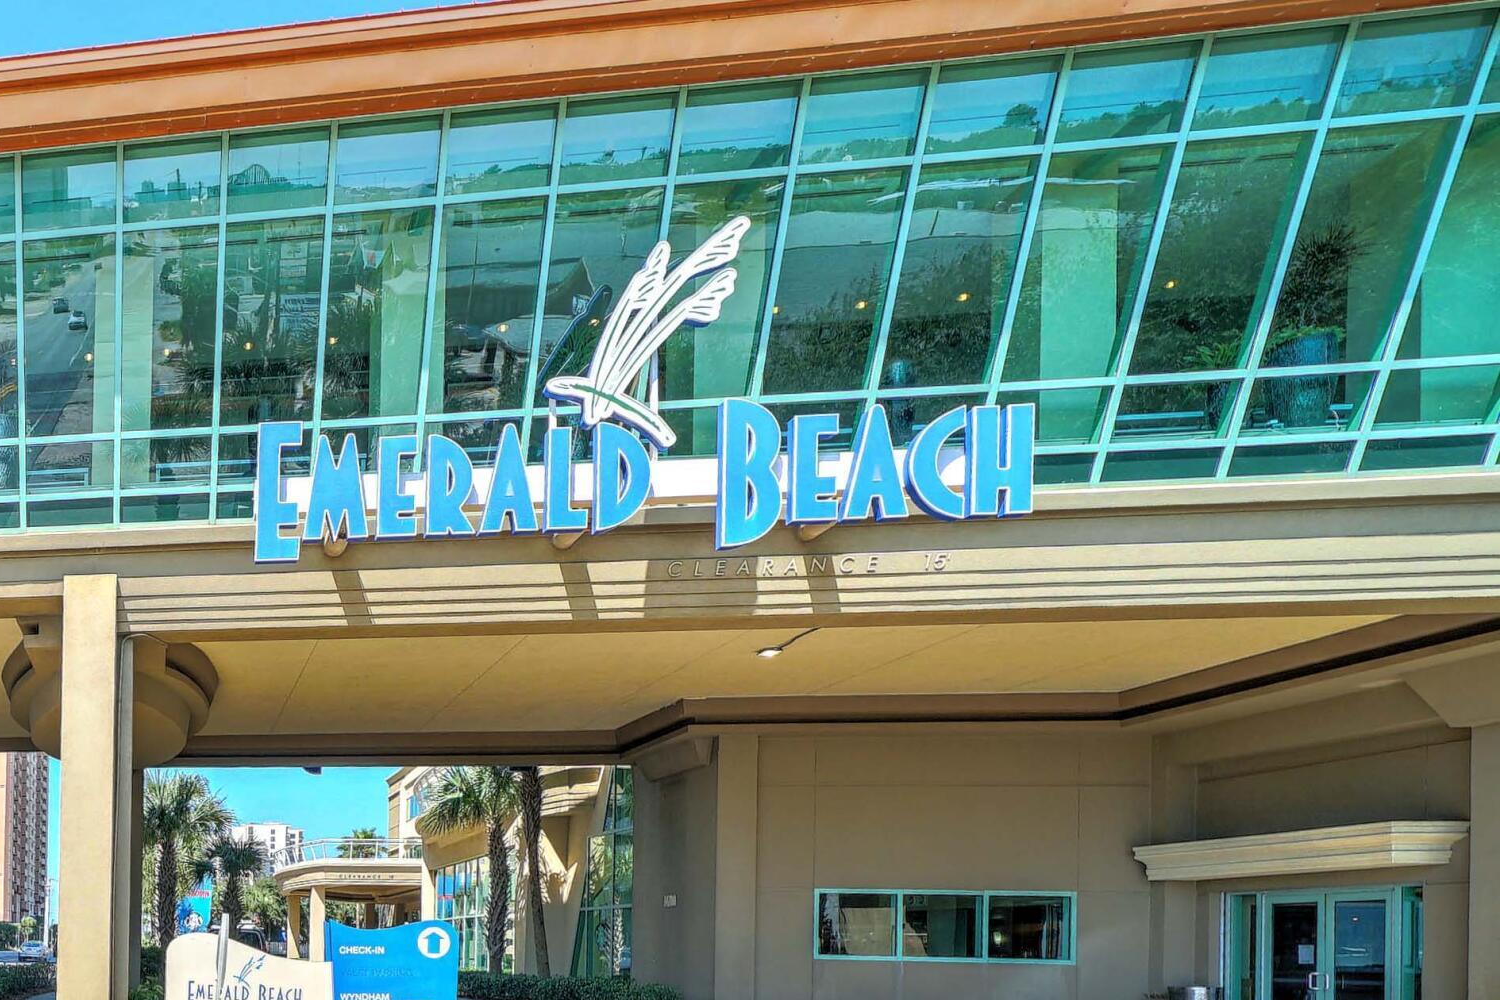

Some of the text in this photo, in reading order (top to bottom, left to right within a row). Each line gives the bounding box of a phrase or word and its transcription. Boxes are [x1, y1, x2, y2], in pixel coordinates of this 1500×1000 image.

[254, 398, 1036, 565] EMERALD BEACH
[667, 553, 880, 578] CLEARANCE
[339, 945, 385, 955] CHECK-IN
[339, 993, 390, 1000] WYNDHAM
